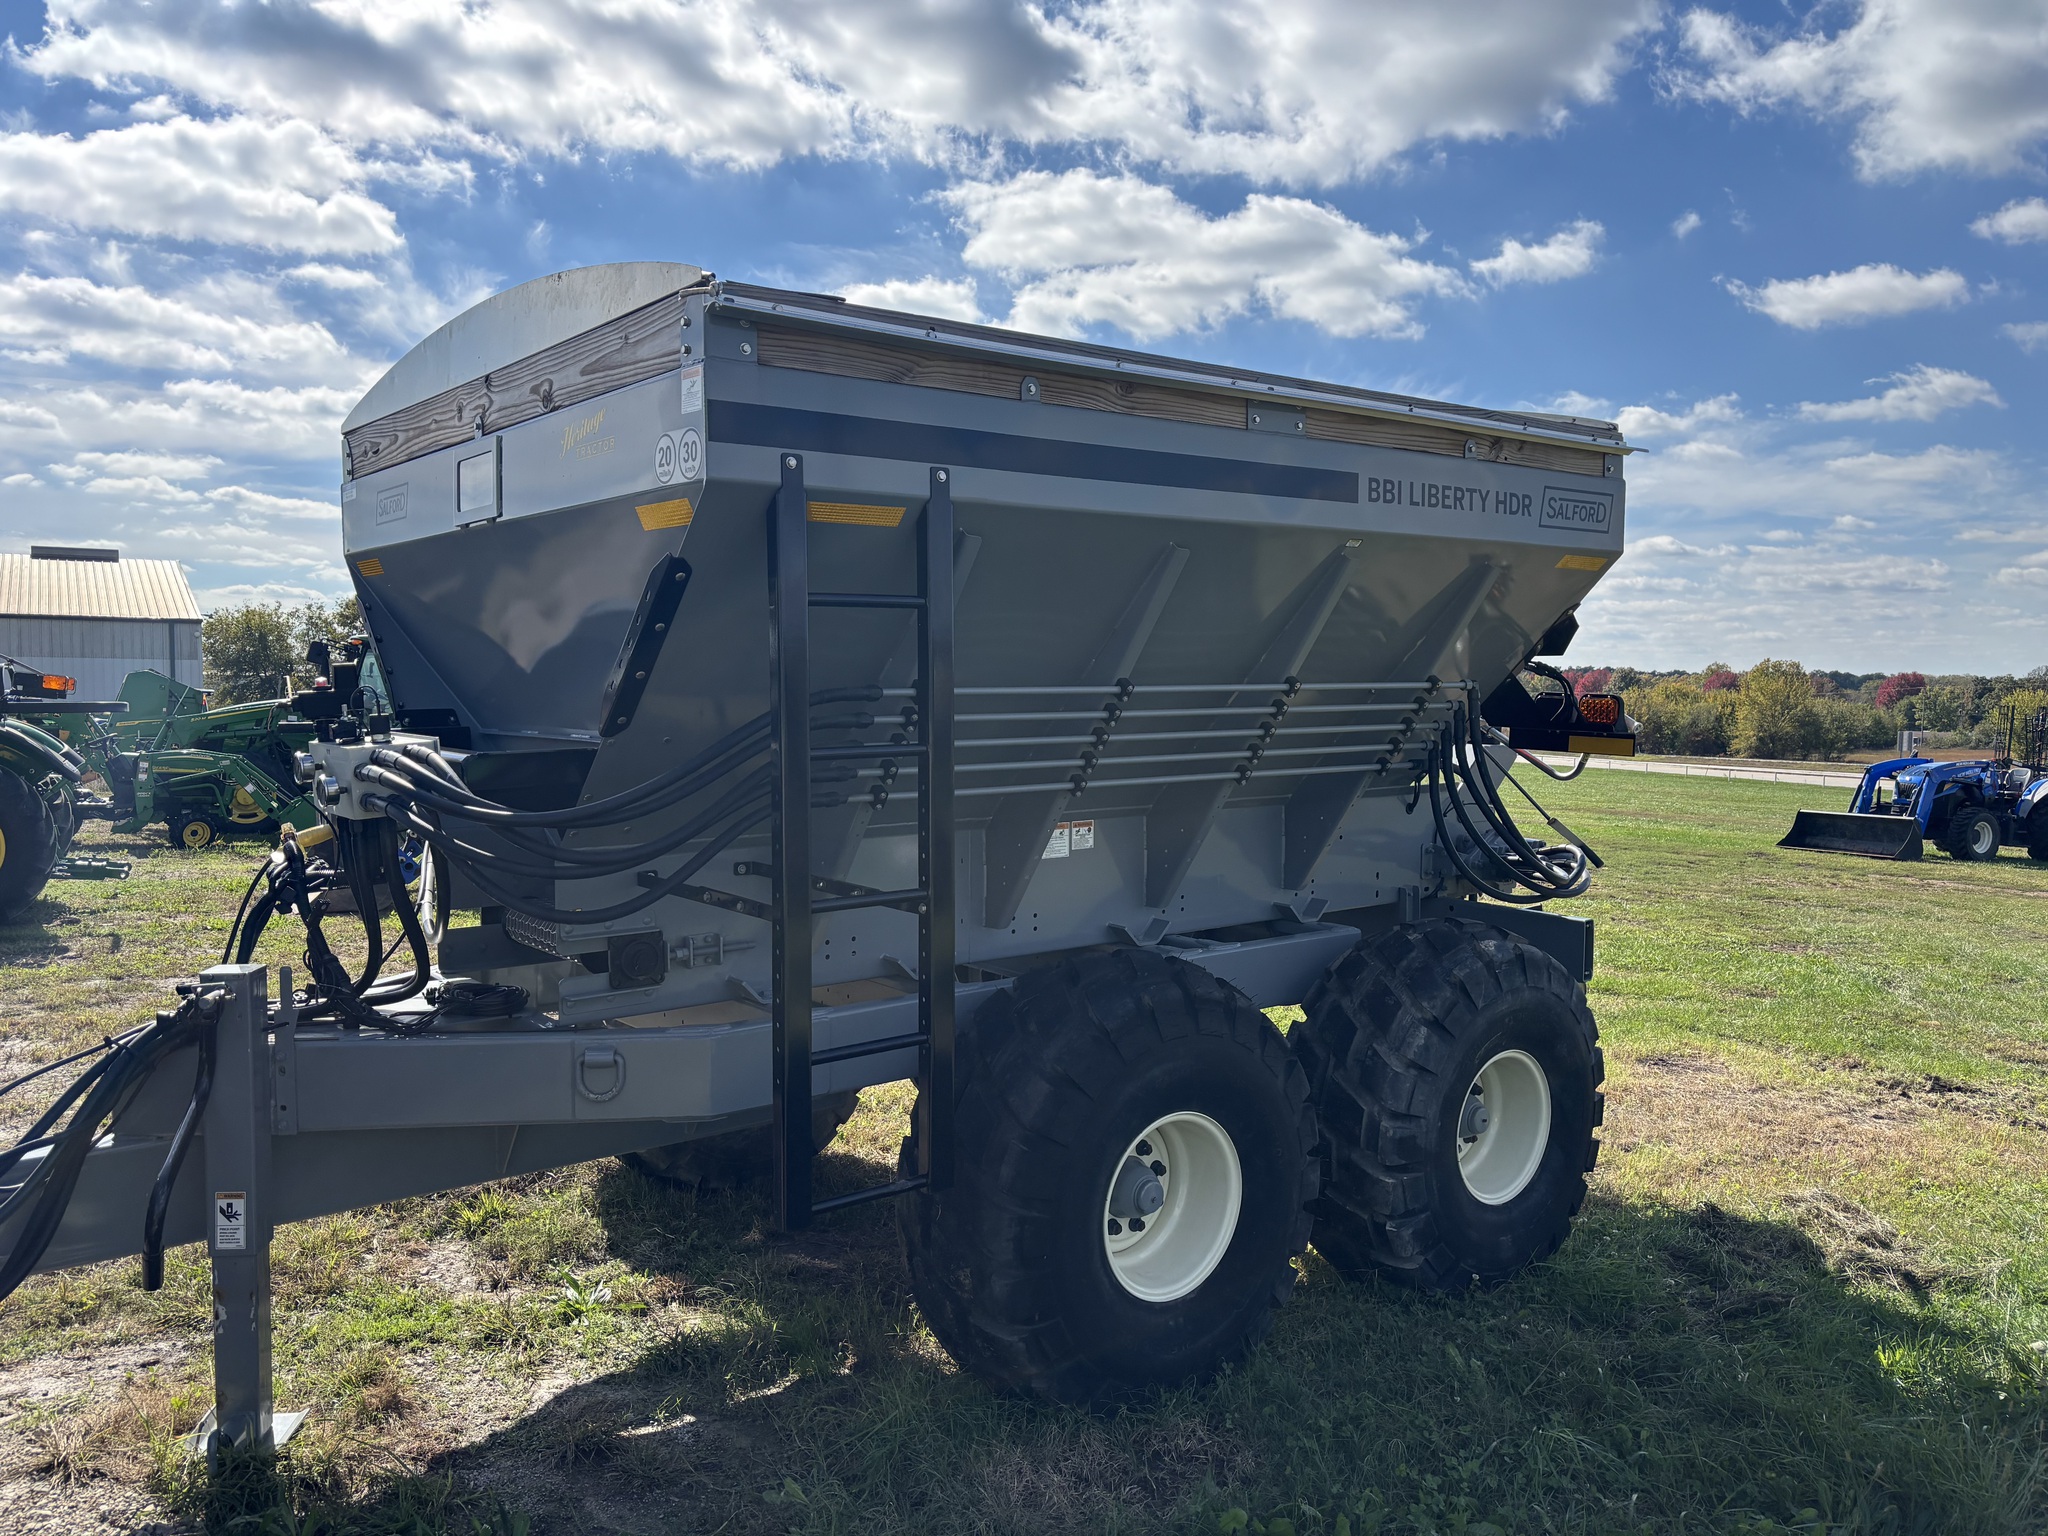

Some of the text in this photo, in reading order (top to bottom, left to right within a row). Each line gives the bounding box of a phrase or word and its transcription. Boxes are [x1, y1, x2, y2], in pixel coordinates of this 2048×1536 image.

[560, 408, 606, 459] Heritage
[576, 438, 615, 459] TRACTOR
[658, 445, 672, 468] 20
[683, 440, 698, 463] 30
[378, 492, 406, 518] SALFORD
[1367, 476, 1533, 517] BBI LIBERTY HDR
[1546, 496, 1607, 524] SALFORD
